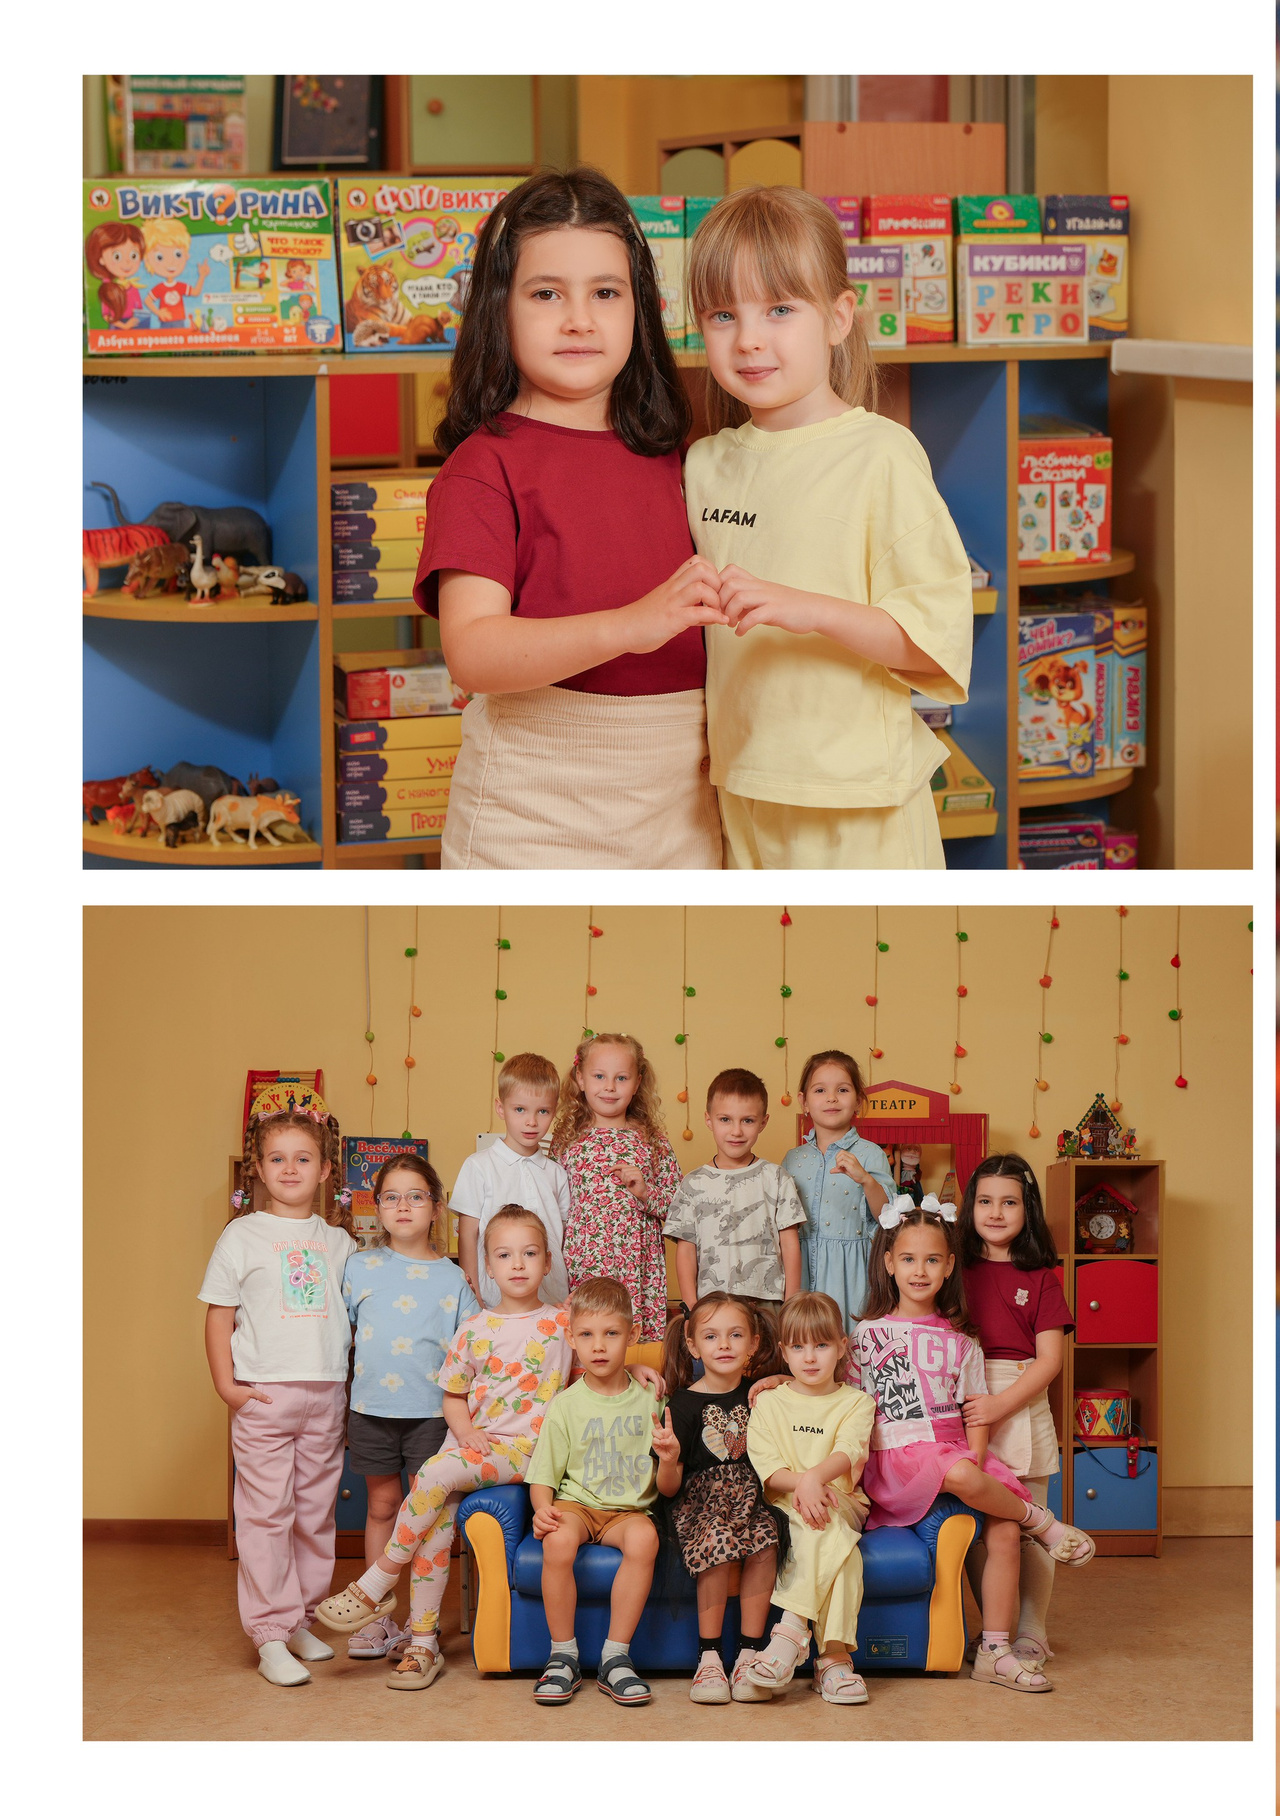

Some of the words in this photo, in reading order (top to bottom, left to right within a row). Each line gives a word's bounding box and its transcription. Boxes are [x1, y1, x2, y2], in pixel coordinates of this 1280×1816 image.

[117, 186, 327, 220] ВИКТОРИНА
[267, 237, 287, 245] ЧТО
[293, 238, 324, 246] ТАКОЕ
[271, 247, 321, 256] ХОРОШО?
[972, 254, 1067, 273] КУБИКИ
[97, 335, 134, 348] Азбука
[137, 334, 184, 347] хорошего
[187, 332, 239, 345] поведения
[1021, 452, 1092, 468] Любимые
[702, 507, 757, 528] LAFAM
[1127, 666, 1140, 731] БУКВЫ
[870, 1100, 916, 1110] ТЕАТР
[357, 1140, 417, 1154] Весёлые
[272, 1241, 288, 1252] MY
[291, 1240, 328, 1253] FLOWER
[581, 1416, 644, 1441] MAKE
[793, 1425, 823, 1434] LAFAM
[584, 1436, 621, 1460] ALL
